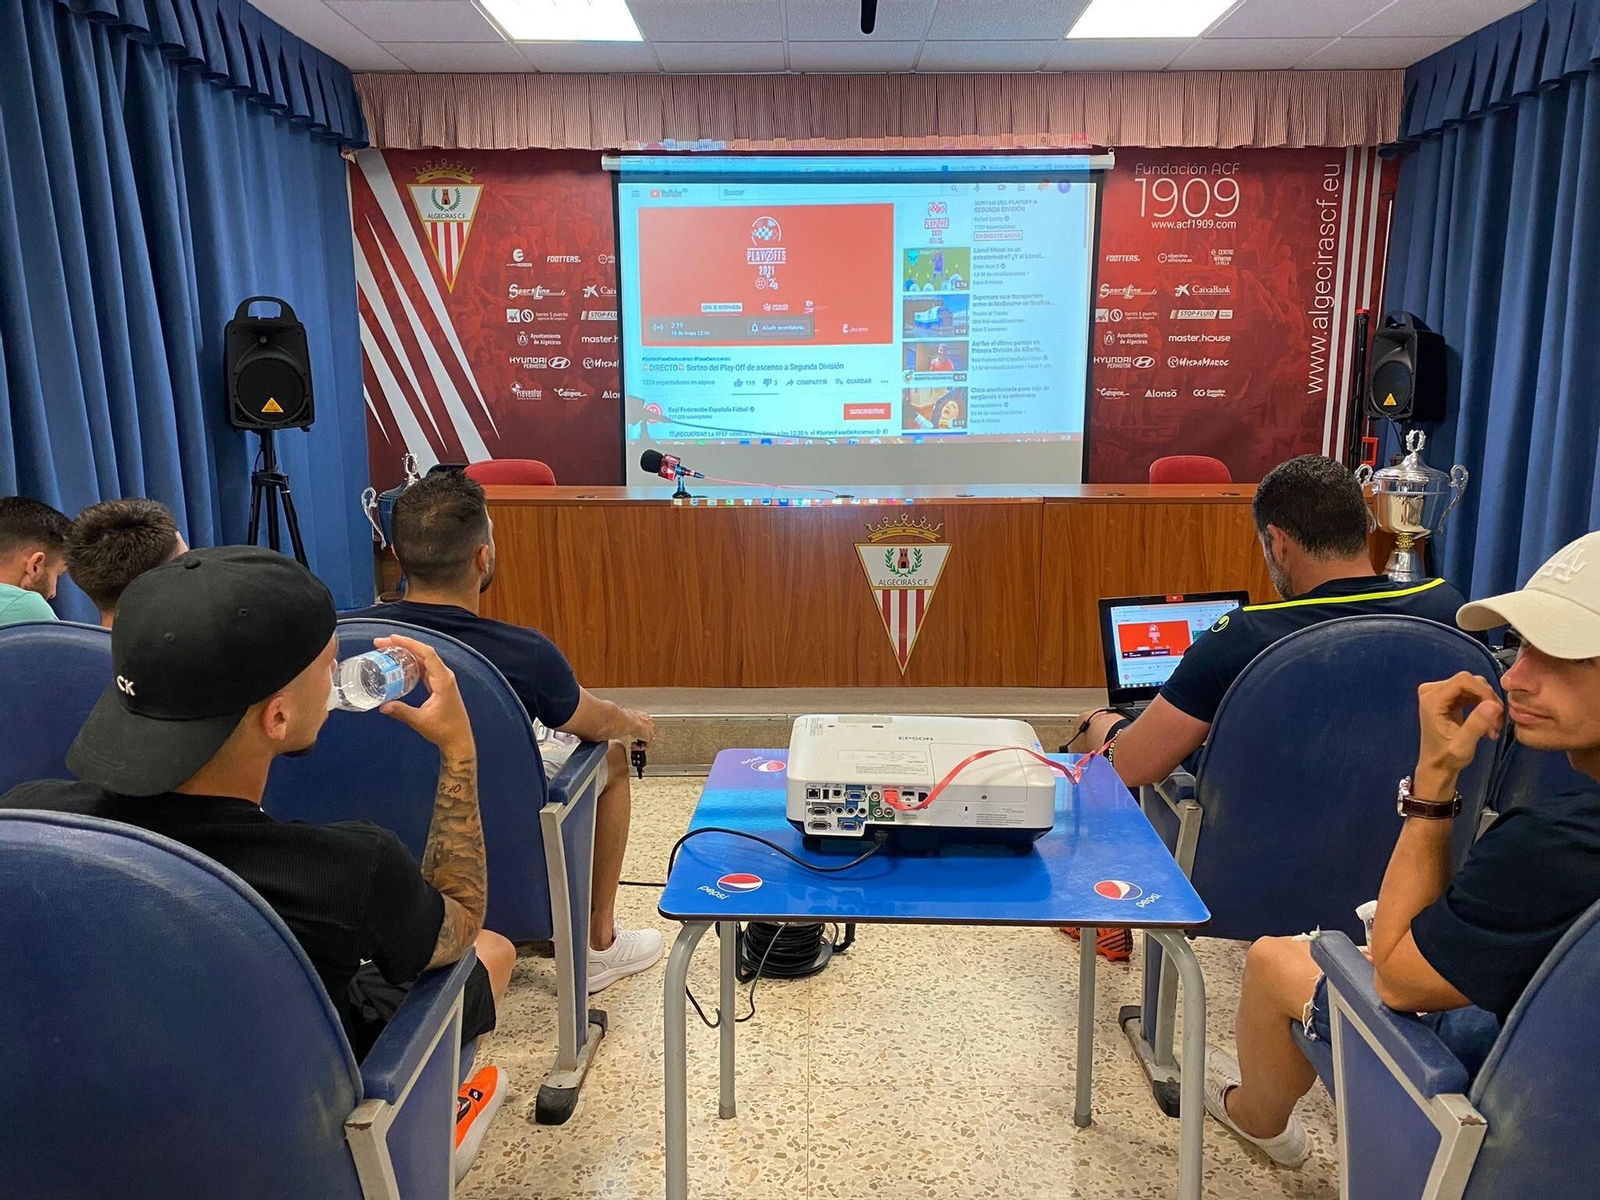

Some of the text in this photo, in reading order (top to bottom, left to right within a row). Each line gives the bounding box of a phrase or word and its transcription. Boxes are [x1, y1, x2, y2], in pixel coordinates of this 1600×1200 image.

[1135, 163, 1240, 175] Fundación ACF
[1135, 178, 1240, 218] 1909
[1151, 219, 1236, 229] www.acf1909.com
[747, 251, 786, 261] PLAYOFFS
[759, 265, 775, 275] 2021
[1307, 163, 1340, 394] www.algecirascf.eu
[1192, 285, 1230, 294] CaixaBank
[1169, 334, 1231, 342] master.house
[720, 364, 734, 372] Play
[790, 363, 817, 372] Segunda
[819, 362, 844, 370] División
[1145, 389, 1177, 398] Alonso
[116, 675, 136, 696] CK
[697, 885, 730, 900] pepsi
[1135, 893, 1163, 908] pepsi
